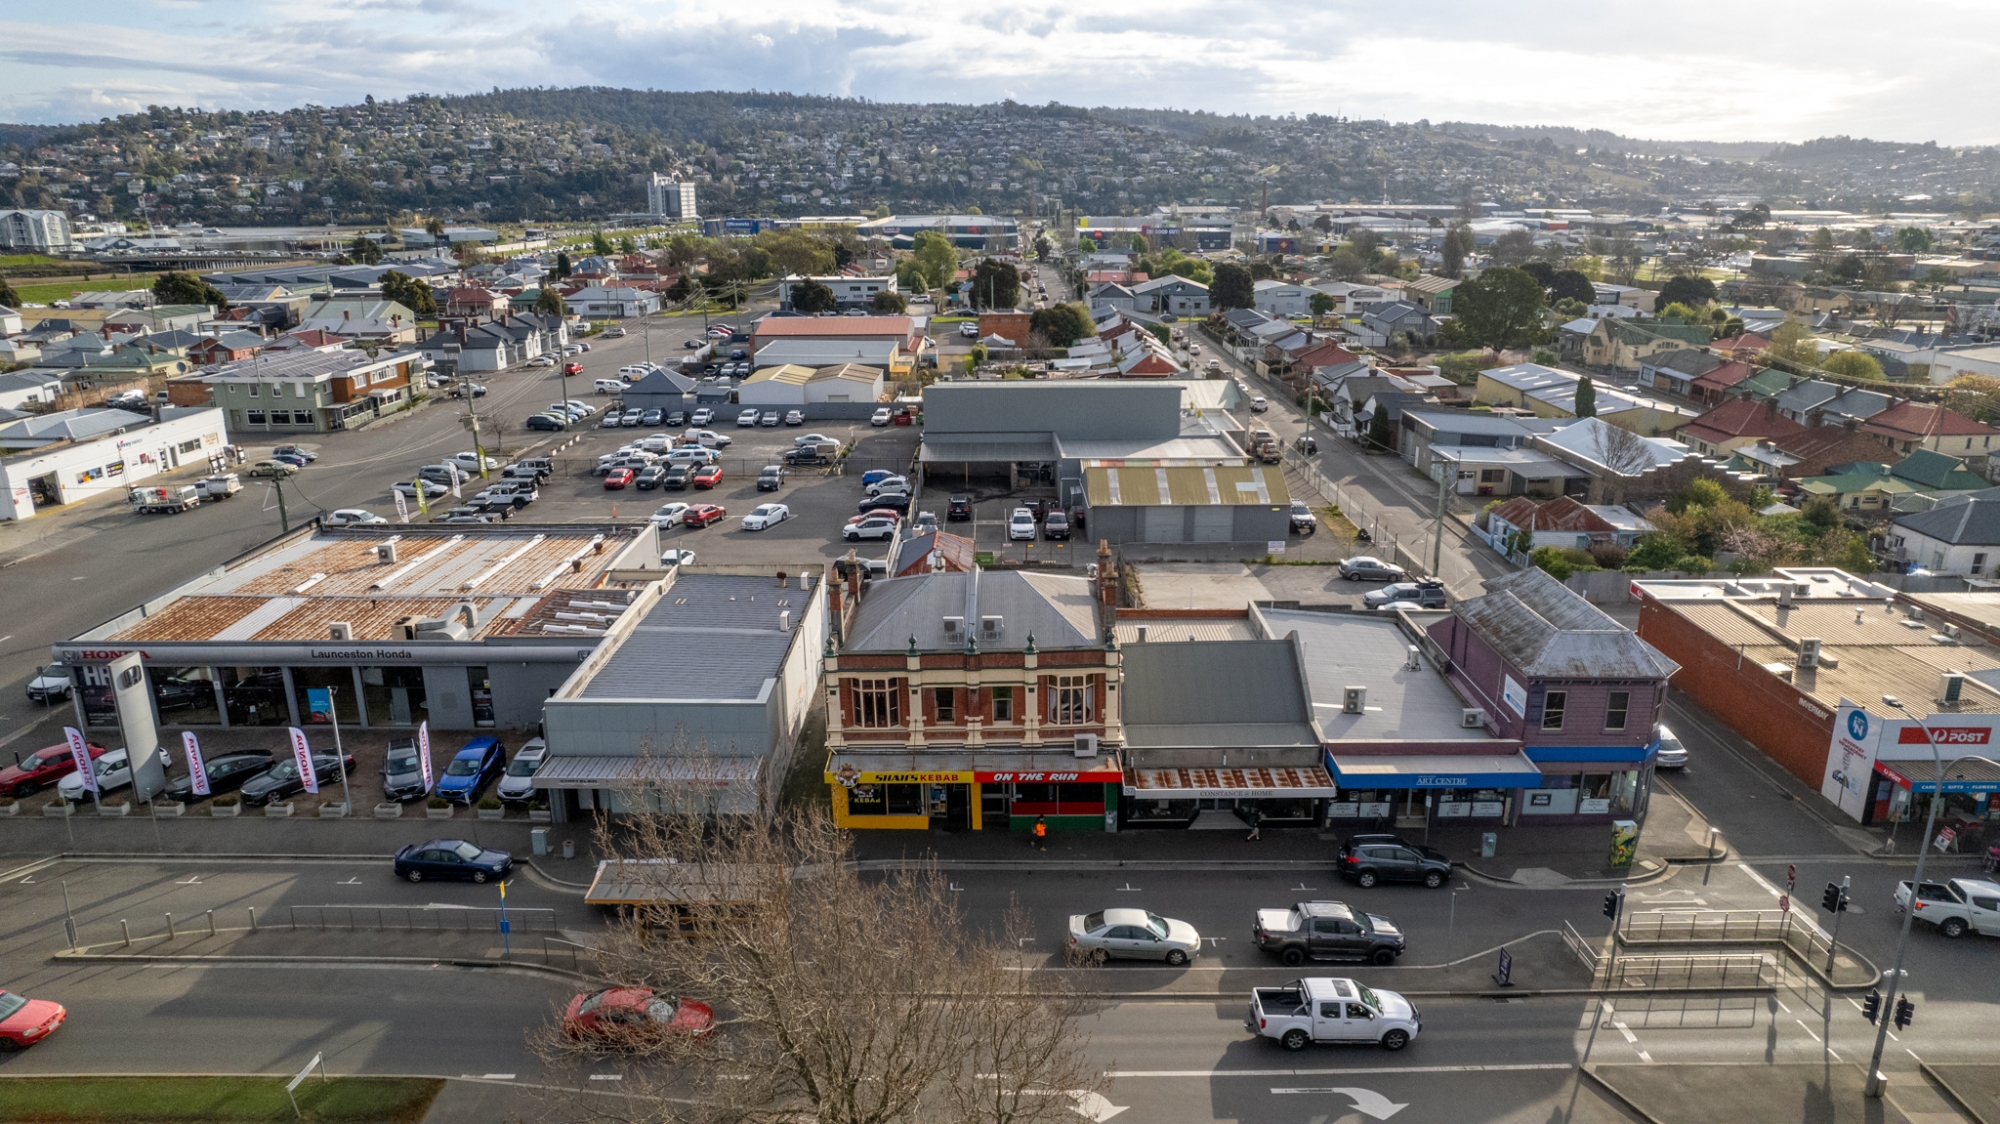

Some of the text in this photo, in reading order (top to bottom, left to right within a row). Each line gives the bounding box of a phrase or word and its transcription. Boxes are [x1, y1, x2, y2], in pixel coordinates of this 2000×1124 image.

[311, 649, 412, 659] Launceston Honda
[1798, 697, 1830, 721] INVERMAY
[1948, 733, 1985, 742] POST
[920, 774, 959, 782] KEBAB
[993, 773, 1079, 781] ON THE RUN
[1124, 787, 1134, 795] 57
